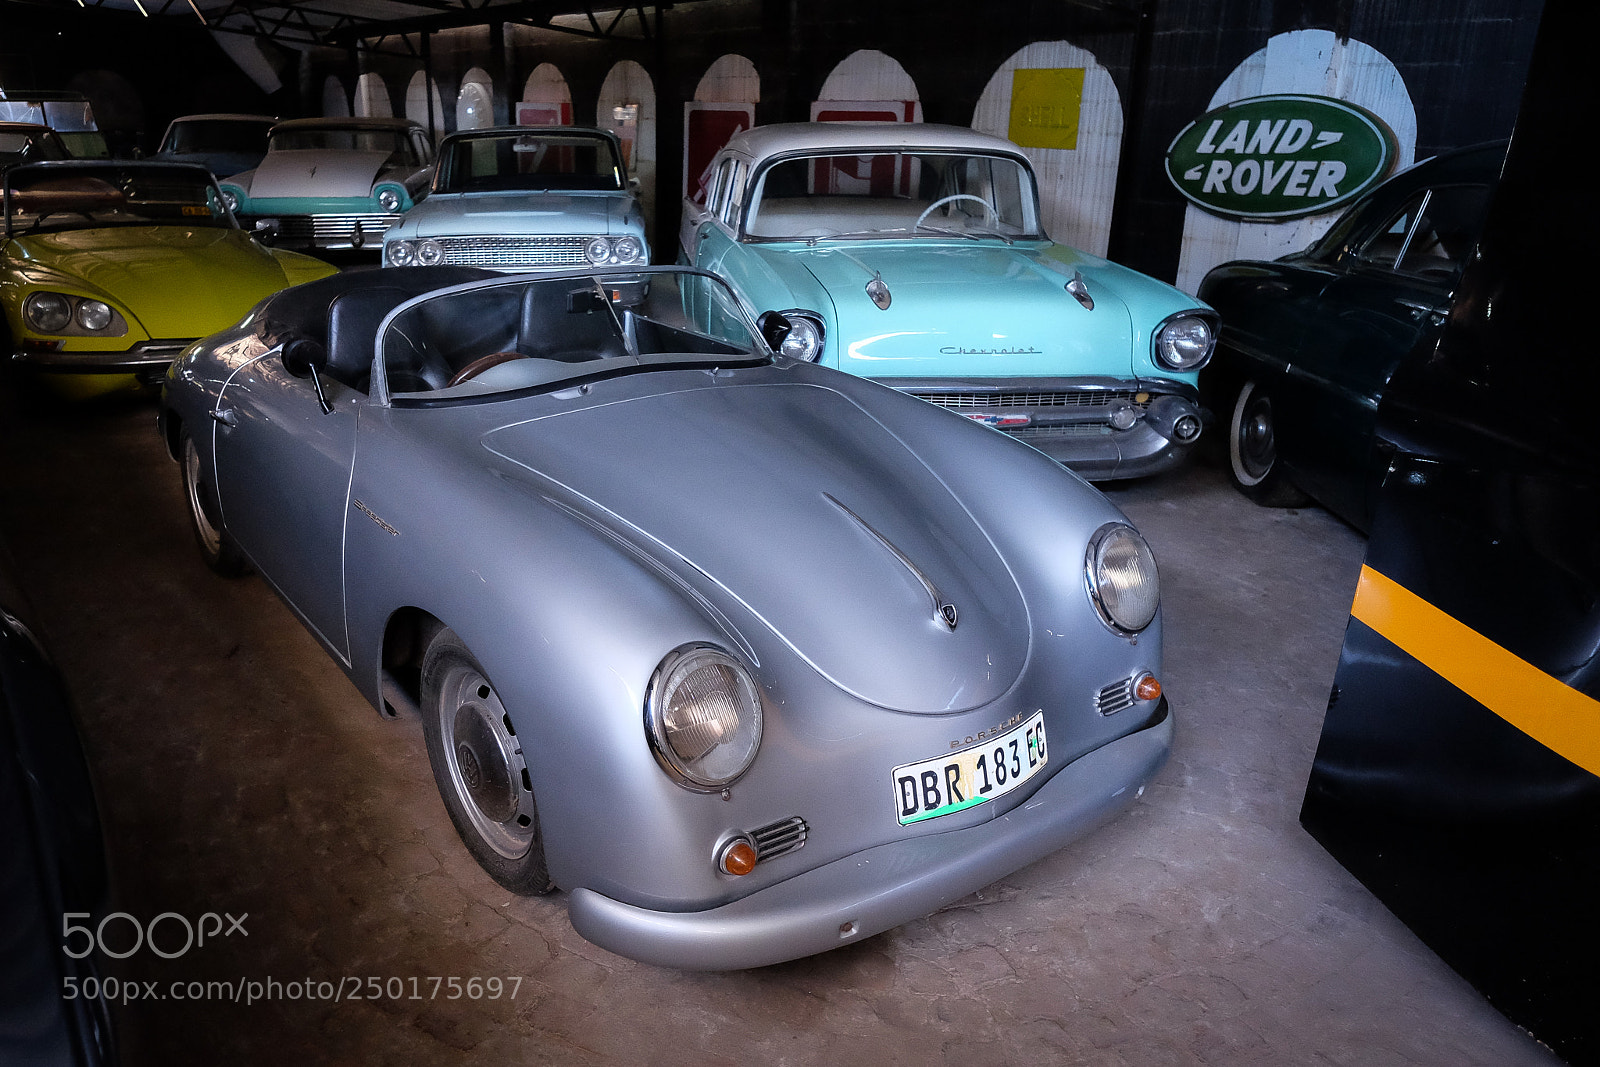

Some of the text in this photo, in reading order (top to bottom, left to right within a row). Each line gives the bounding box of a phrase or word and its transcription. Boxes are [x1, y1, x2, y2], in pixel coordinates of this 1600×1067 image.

[1196, 119, 1314, 155] LAND
[1202, 159, 1347, 198] ROVER
[939, 346, 1043, 355] Chevrolet
[949, 711, 1024, 749] PORSCHE
[897, 721, 1045, 817] DBR 183 EC
